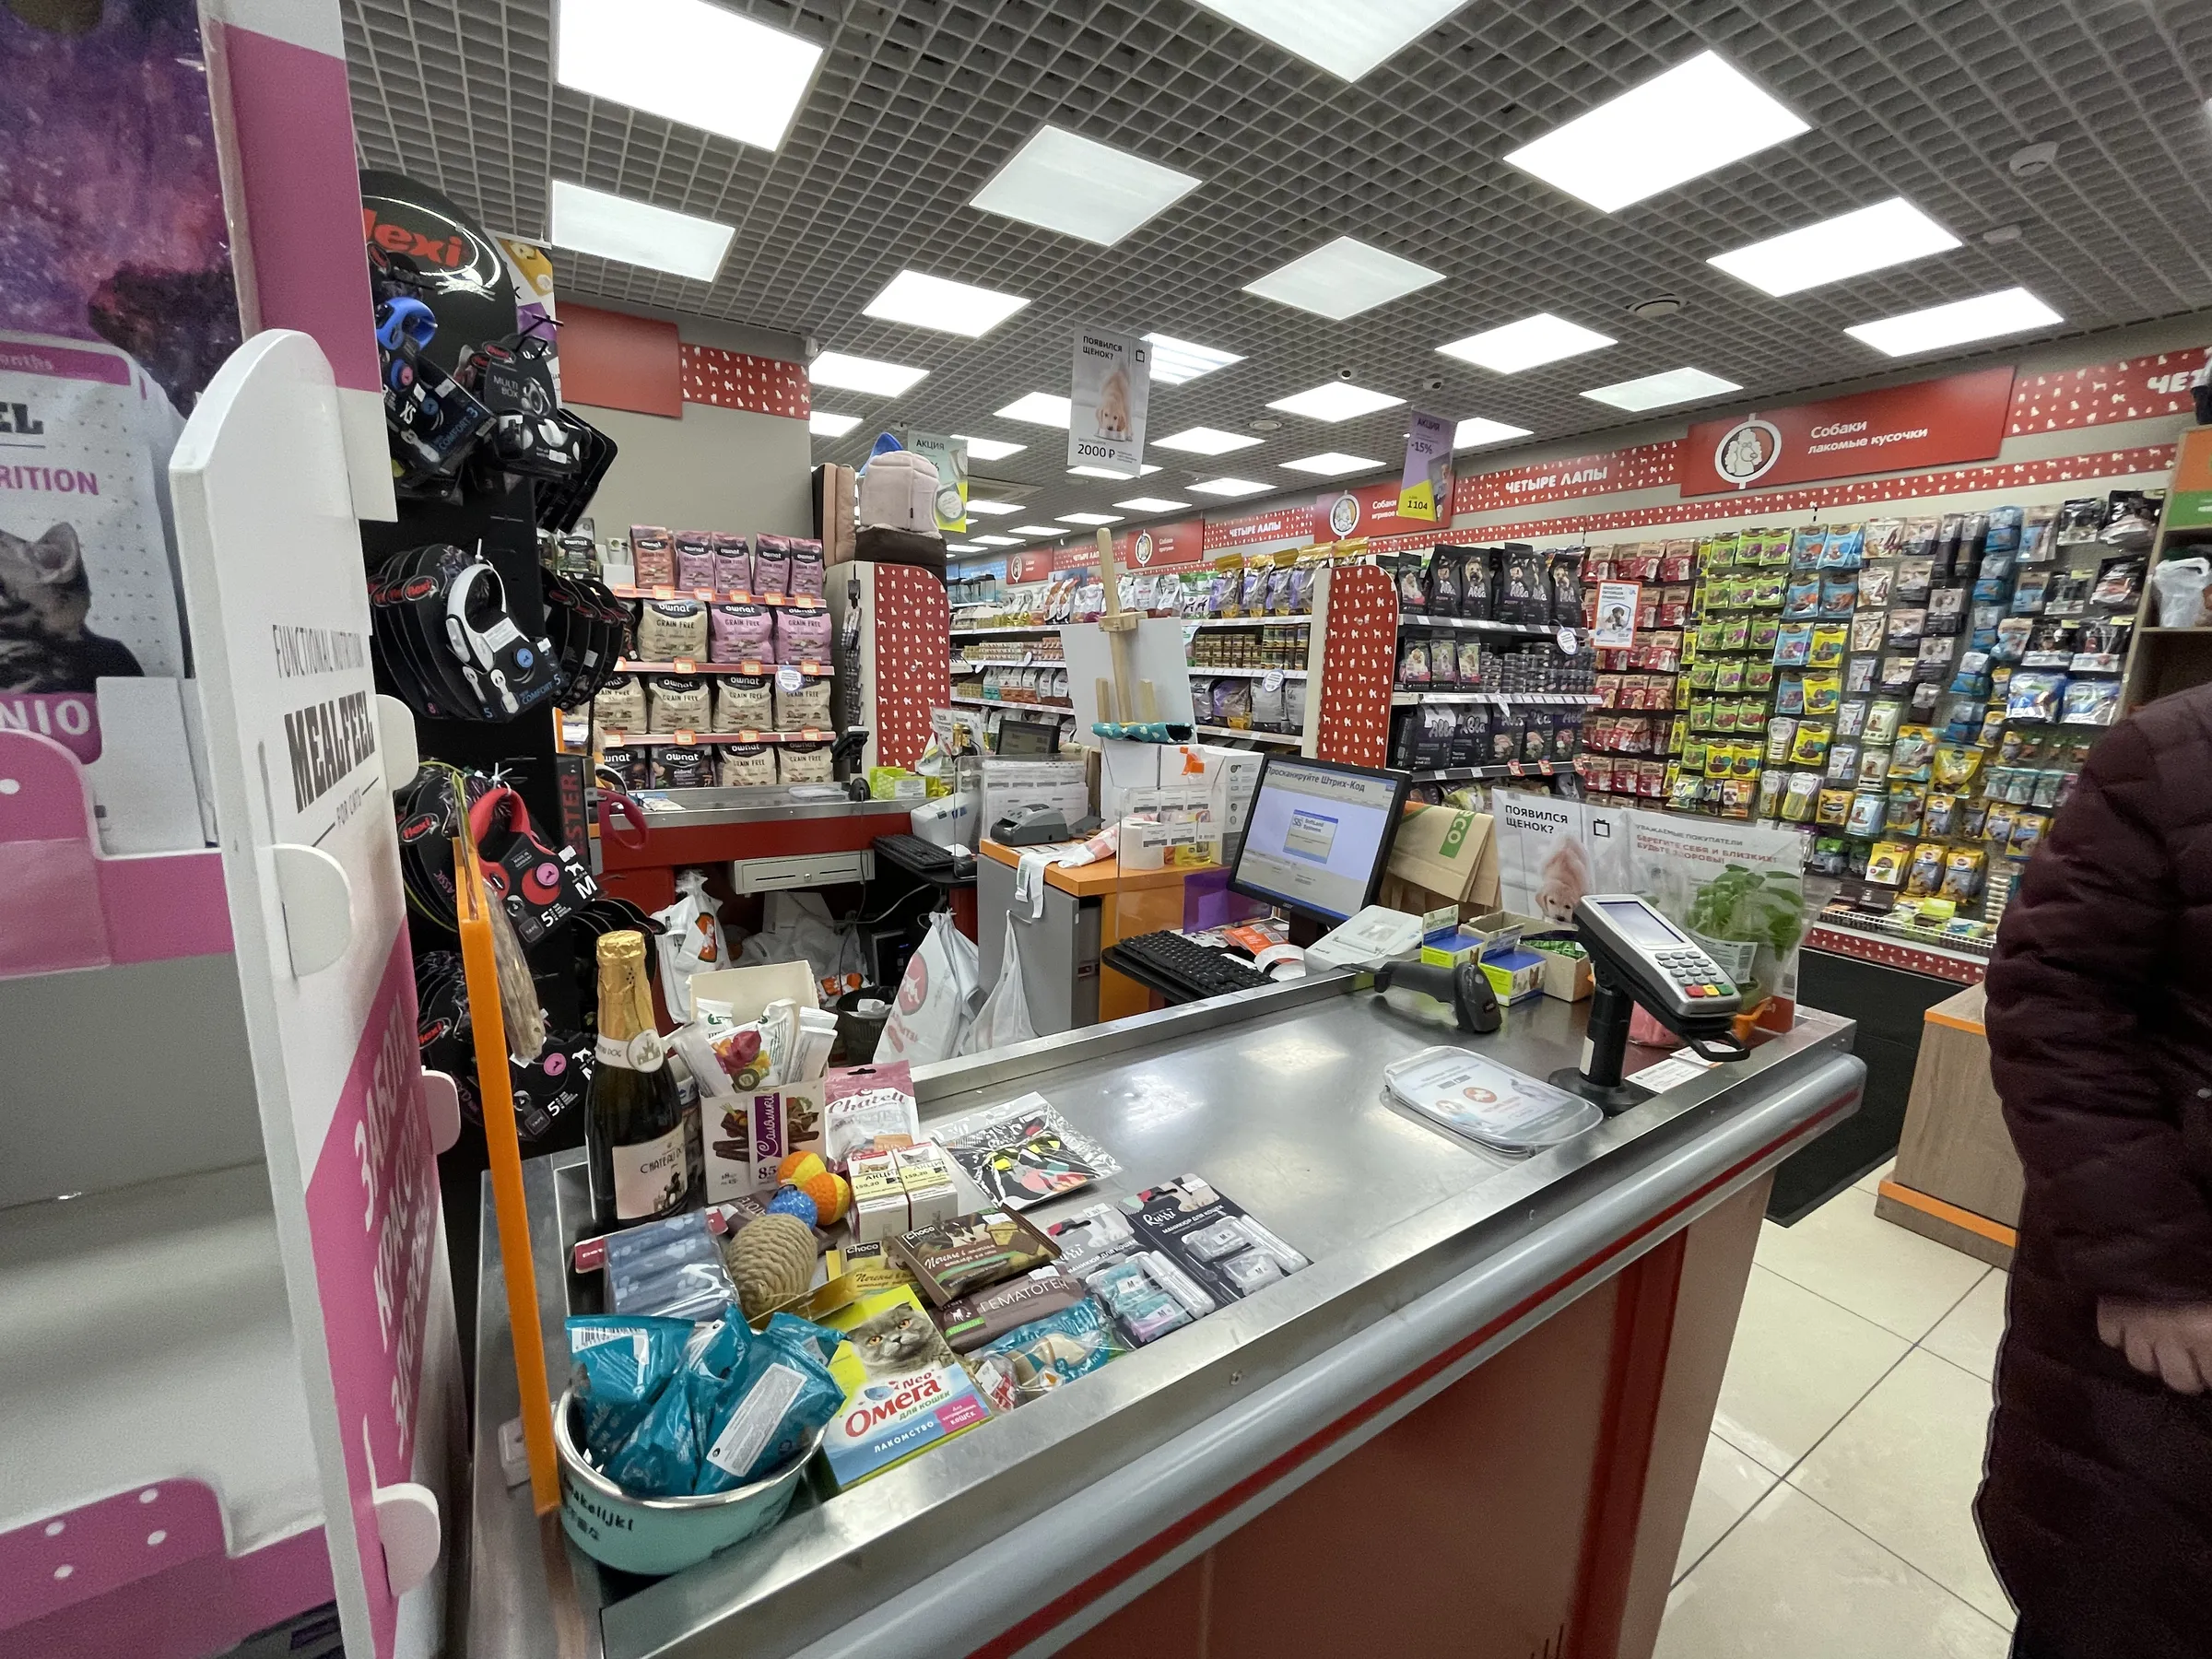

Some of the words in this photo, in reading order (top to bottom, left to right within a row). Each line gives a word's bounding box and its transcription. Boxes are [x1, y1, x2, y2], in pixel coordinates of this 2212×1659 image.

[362, 208, 462, 266] lexi
[1083, 335, 1123, 352] ПОЯВИЛСЯ
[1082, 346, 1113, 360] ЩЕНОК?
[493, 375, 519, 390] MULTI
[2147, 368, 2205, 394] ЧЕТ
[500, 385, 519, 400] BOX
[1418, 417, 1441, 431] АКЦИЯ
[1810, 418, 1867, 439] Собаки
[916, 439, 945, 451] АКЦИЯ
[1411, 441, 1433, 455] -15%
[1808, 436, 1868, 454] лакомые
[1870, 427, 1929, 447] кусочки
[1077, 444, 1107, 458] 2000
[1505, 472, 1556, 493] ЧЕТЫРЕ
[1560, 466, 1607, 487] ЛАПЫ
[1372, 499, 1397, 509] Собаки
[1407, 500, 1428, 511] 1104
[1229, 524, 1257, 538] ЧЕТЫРЕ
[1257, 522, 1281, 534] ЛАПЫ
[658, 604, 690, 613] ownat
[656, 619, 677, 628] GRAIN
[605, 677, 624, 687] nat
[664, 678, 693, 688] ownat
[731, 677, 759, 686] ownat
[521, 679, 553, 706] COMFORT
[553, 674, 561, 686] 5
[483, 707, 493, 719] 5
[284, 689, 376, 815] MEALFEEL
[732, 743, 760, 752] ownat
[665, 752, 699, 761] ownat
[790, 755, 806, 763] GRAIN
[1266, 766, 1320, 783] Просканируйте
[1321, 776, 1365, 793] Штрих-Код
[1505, 805, 1568, 824] ПОЯВИЛСЯ
[1506, 817, 1554, 834] ЩЕНОК?
[1686, 834, 1743, 846] ПОКУПАТЕЛИ
[1682, 843, 1709, 853] СЕБЯ
[574, 876, 598, 900] M
[541, 910, 554, 928] 5
[418, 1020, 443, 1044] lexi
[547, 1100, 560, 1116] 5
[865, 1170, 897, 1182] АКЦИ
[1161, 1218, 1193, 1234] МАНИКЮР
[1193, 1213, 1206, 1224] ДЛЯ
[1068, 1256, 1100, 1274] МАНИКЮР
[1100, 1249, 1114, 1260] ДЛЯ
[980, 1279, 1070, 1313] ГЕМАТОГЕН
[1158, 1309, 1166, 1317] M
[844, 1378, 942, 1438] Омега
[899, 1406, 918, 1421] ДЛЯ
[919, 1391, 950, 1411] КОШЕК
[874, 1420, 935, 1453] ЛАКОМСТВО
